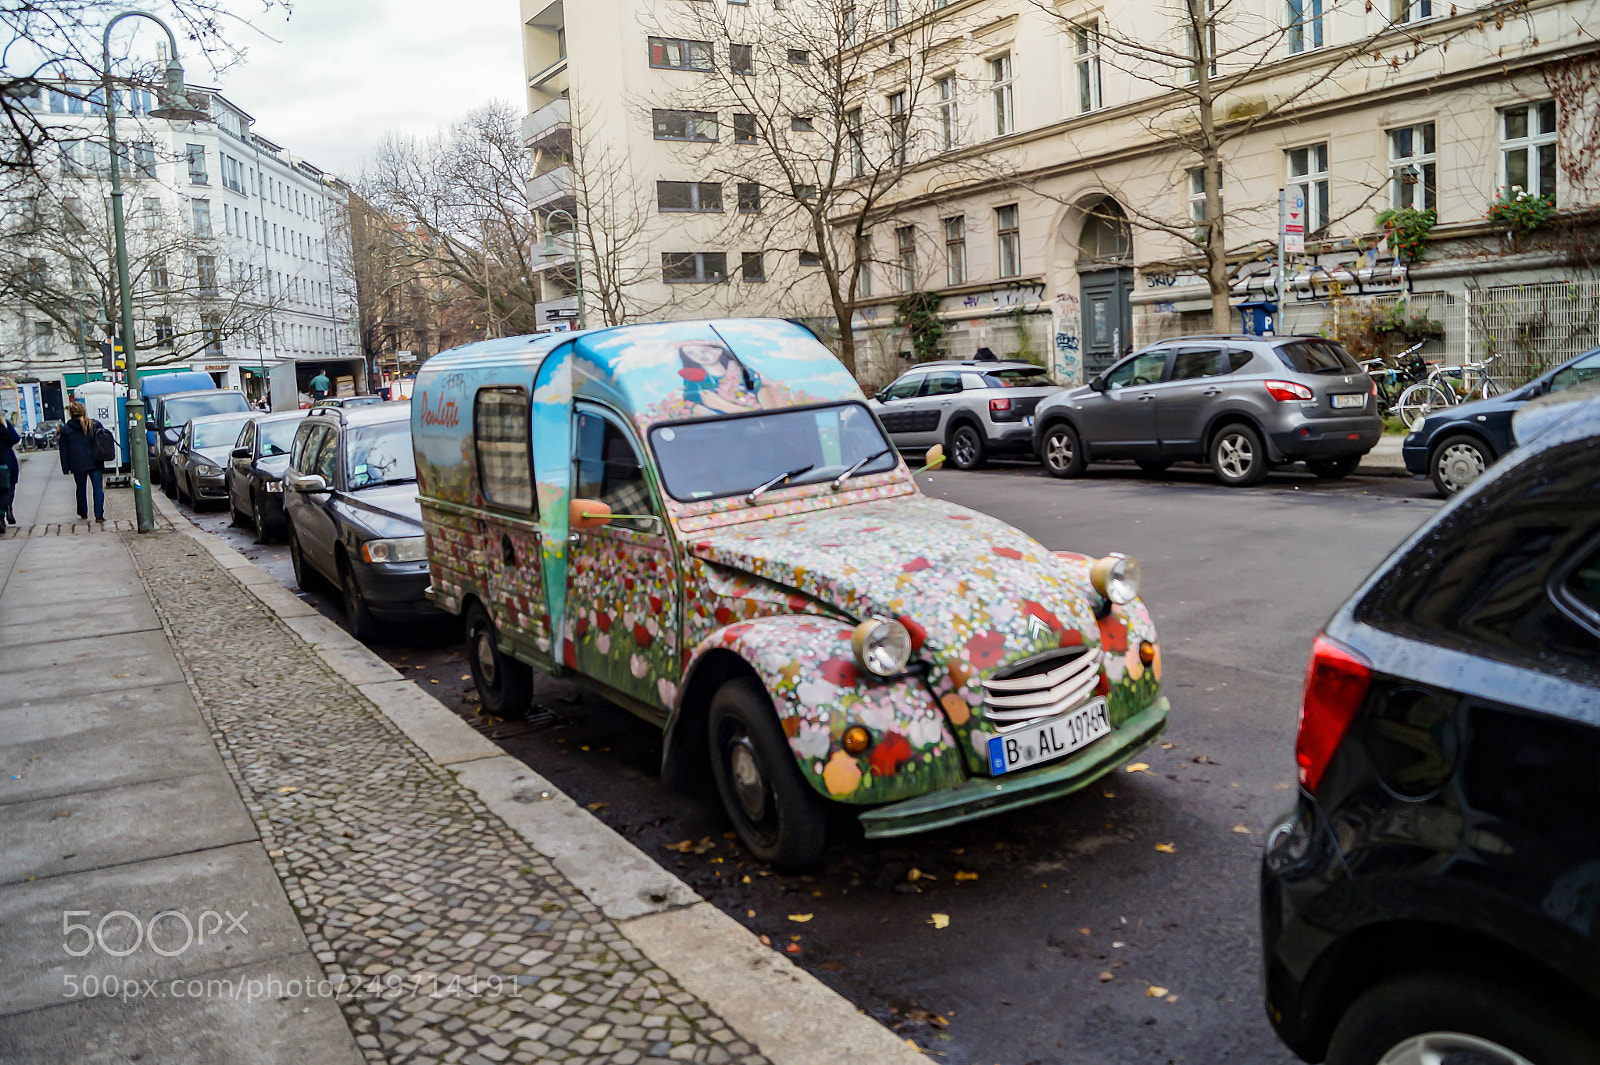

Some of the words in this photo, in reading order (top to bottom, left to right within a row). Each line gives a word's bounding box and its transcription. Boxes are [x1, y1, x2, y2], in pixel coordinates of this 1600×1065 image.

[1006, 738, 1020, 765] B
[1039, 727, 1064, 756] AL
[1067, 703, 1107, 746] 1976H
